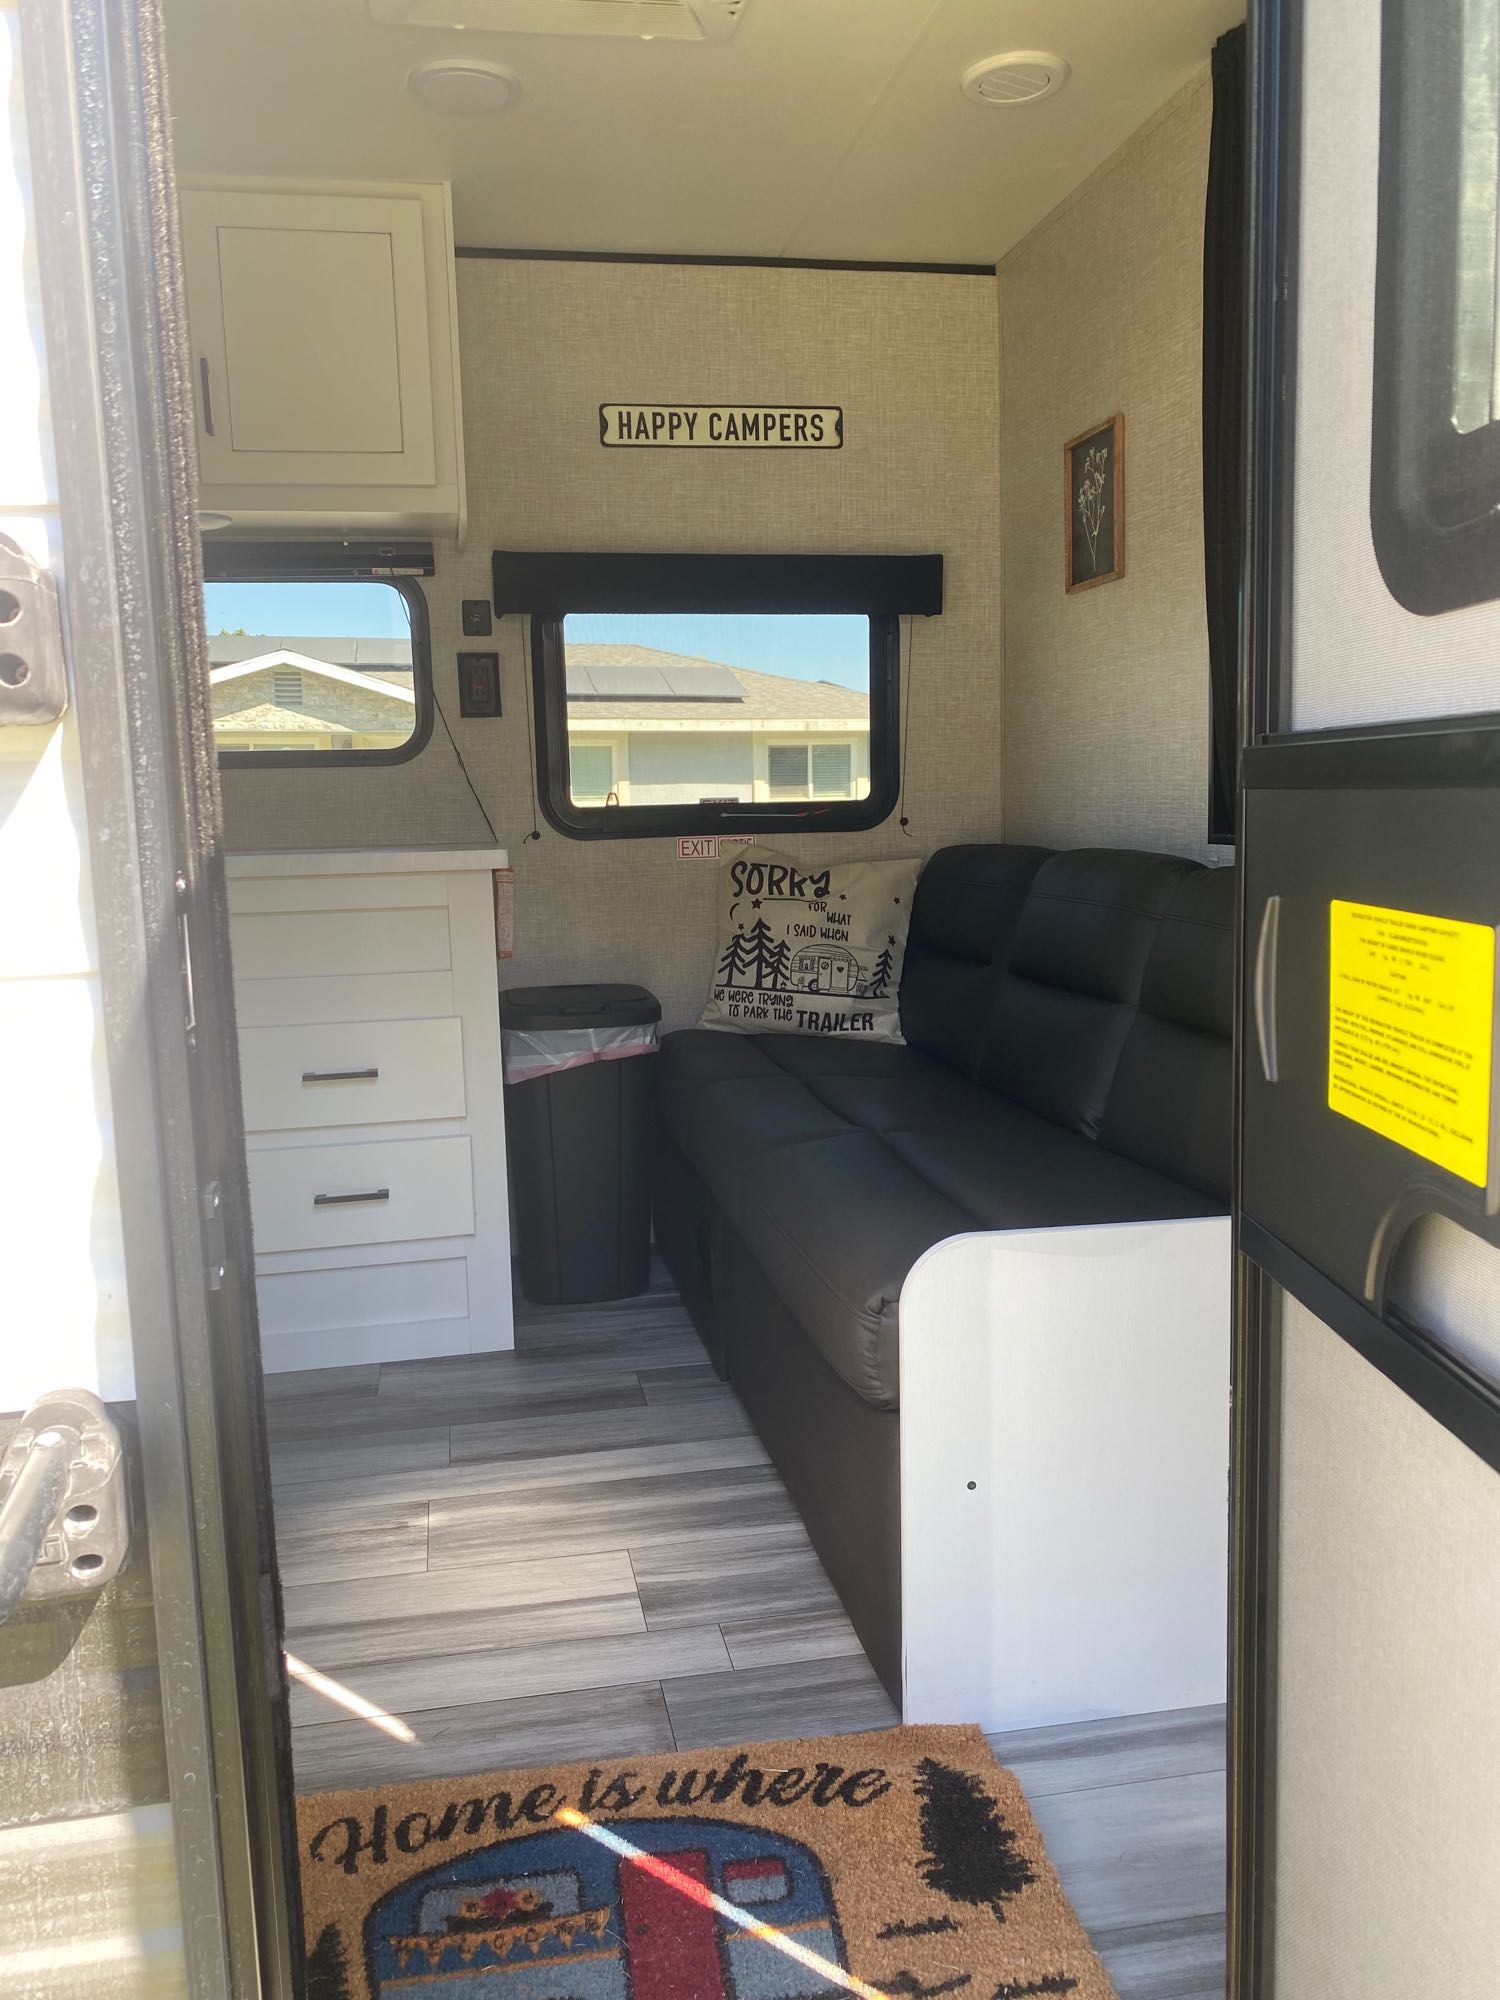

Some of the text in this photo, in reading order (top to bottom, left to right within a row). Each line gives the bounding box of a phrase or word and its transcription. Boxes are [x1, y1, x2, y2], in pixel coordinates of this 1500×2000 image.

[618, 411, 824, 442] HAPPY CAMPERS
[681, 839, 713, 857] EXIT
[808, 901, 828, 913] FOR
[826, 911, 852, 926] WHAT
[794, 923, 817, 938] SAID
[820, 927, 849, 942] WHEN
[728, 990, 754, 1004] WERE
[758, 992, 794, 1007] TRYING
[728, 1004, 874, 1033] TO PARK THE TRAILER
[309, 1753, 893, 1874] Home is where
